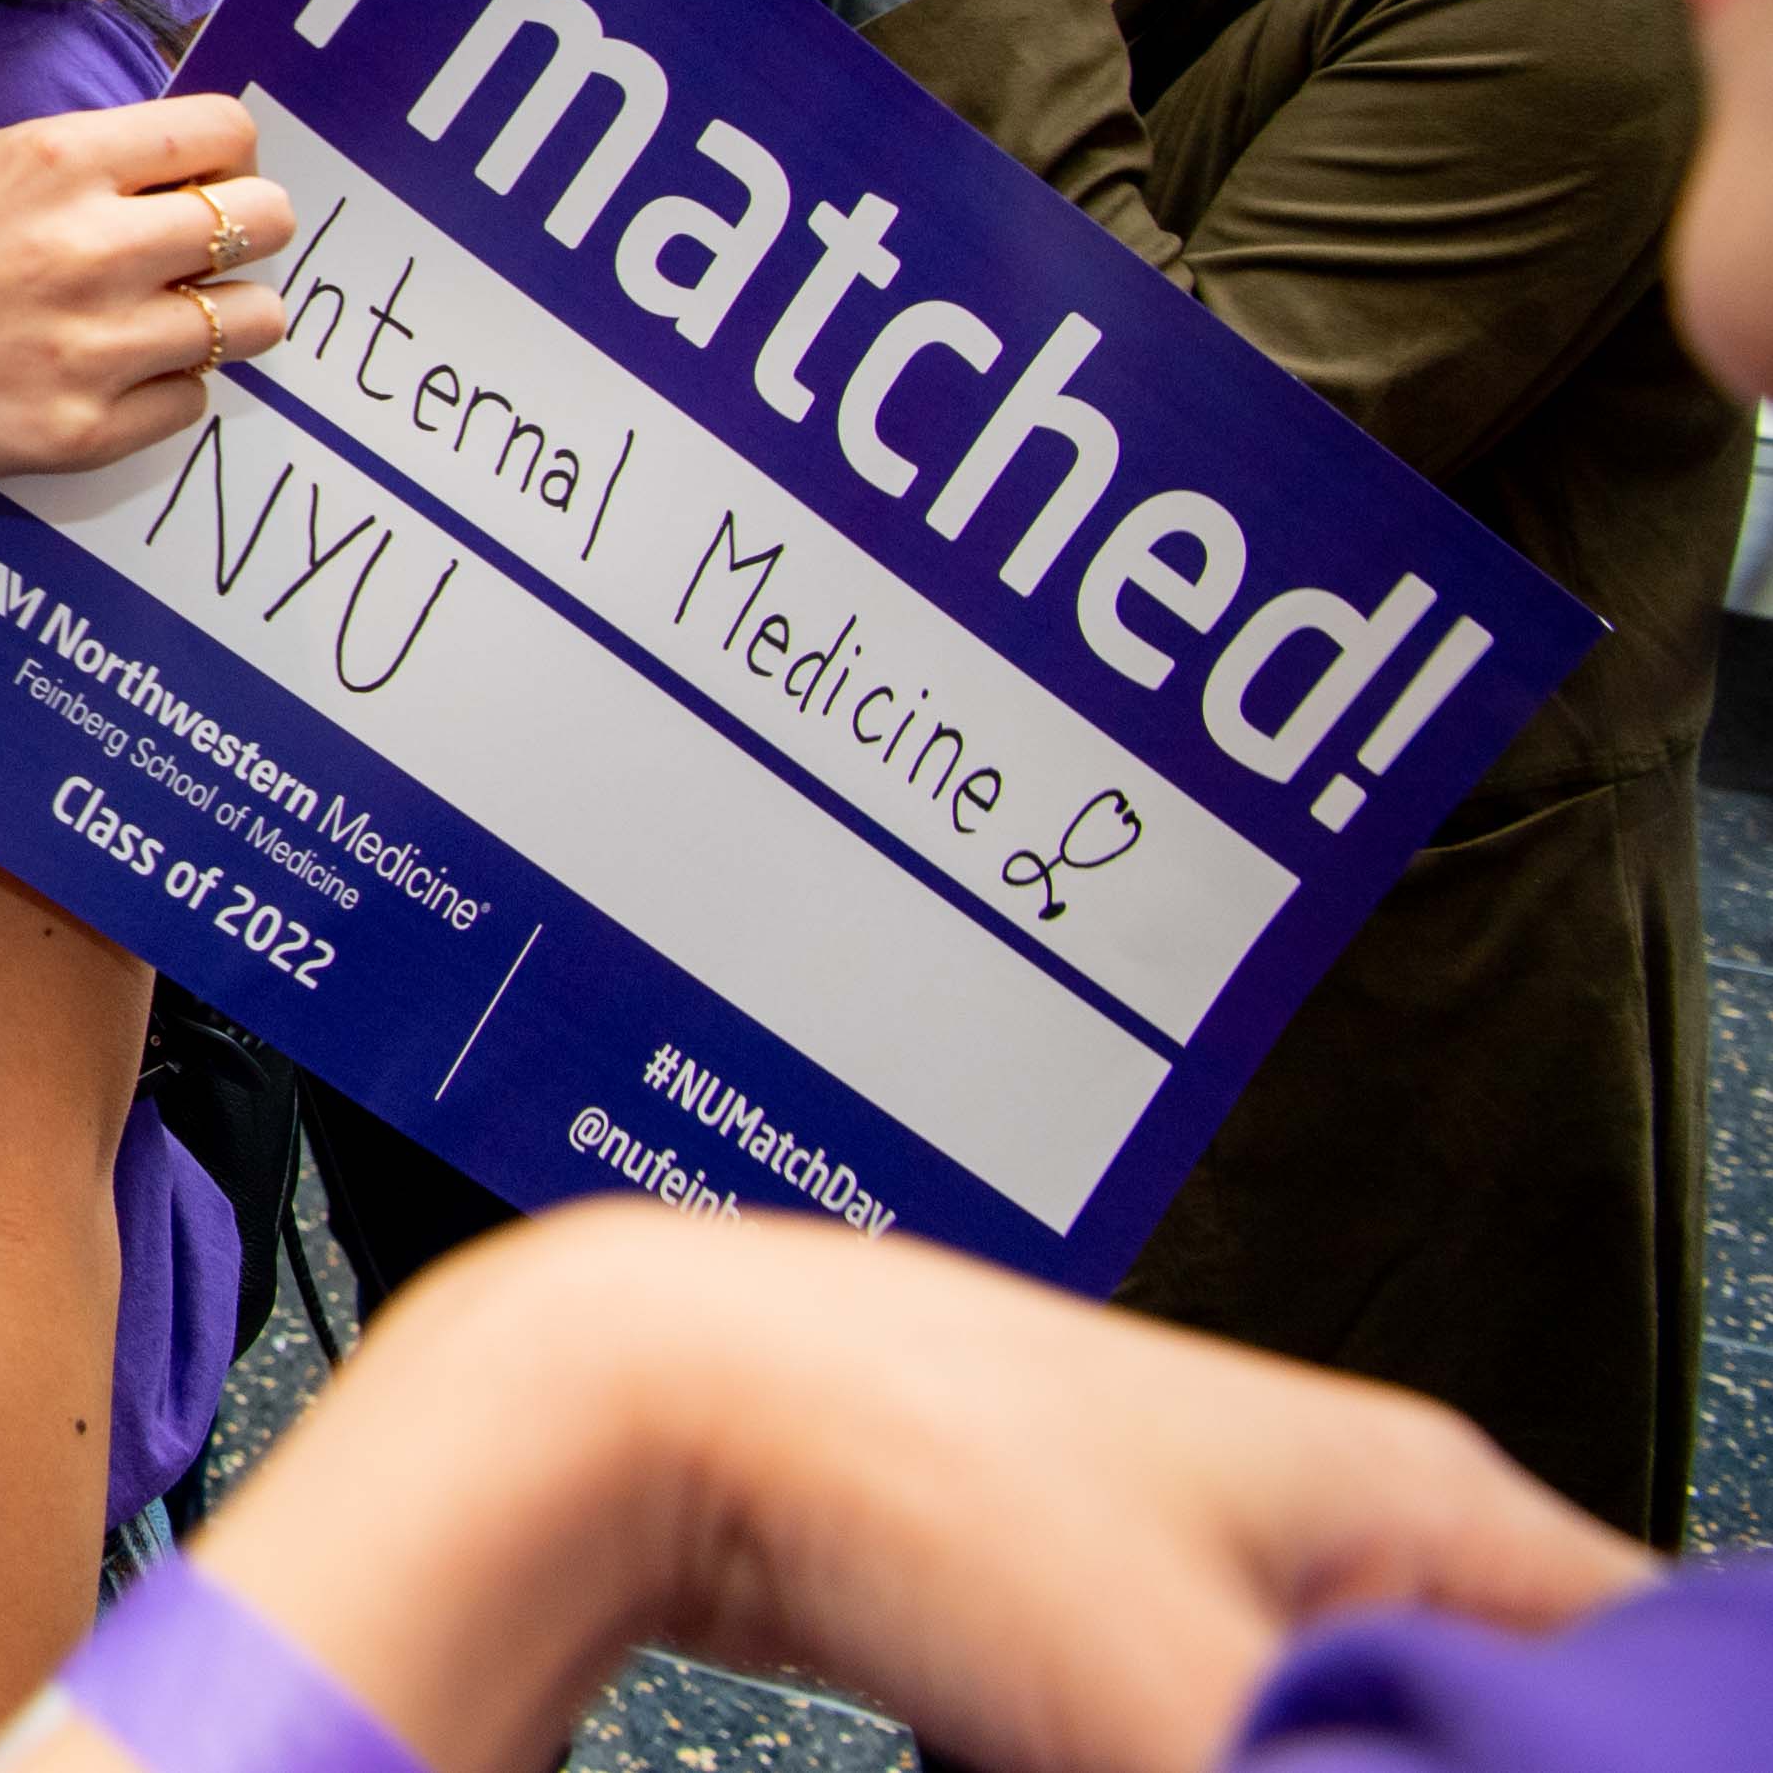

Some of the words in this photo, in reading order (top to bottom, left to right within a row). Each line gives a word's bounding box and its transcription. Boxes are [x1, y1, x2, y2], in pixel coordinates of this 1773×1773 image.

[144, 414, 459, 693] NYU
[278, 196, 634, 562] Internal
[671, 510, 1004, 837] Medicine
[14, 658, 129, 758] Feinberg
[130, 738, 219, 812] School
[215, 803, 251, 831] of
[245, 816, 360, 910] Medicine
[38, 603, 318, 821] Northwestern
[53, 776, 165, 876] Class
[164, 860, 224, 910] of
[213, 884, 336, 990] 2022
[643, 1043, 896, 1239] #NUMatchDay
